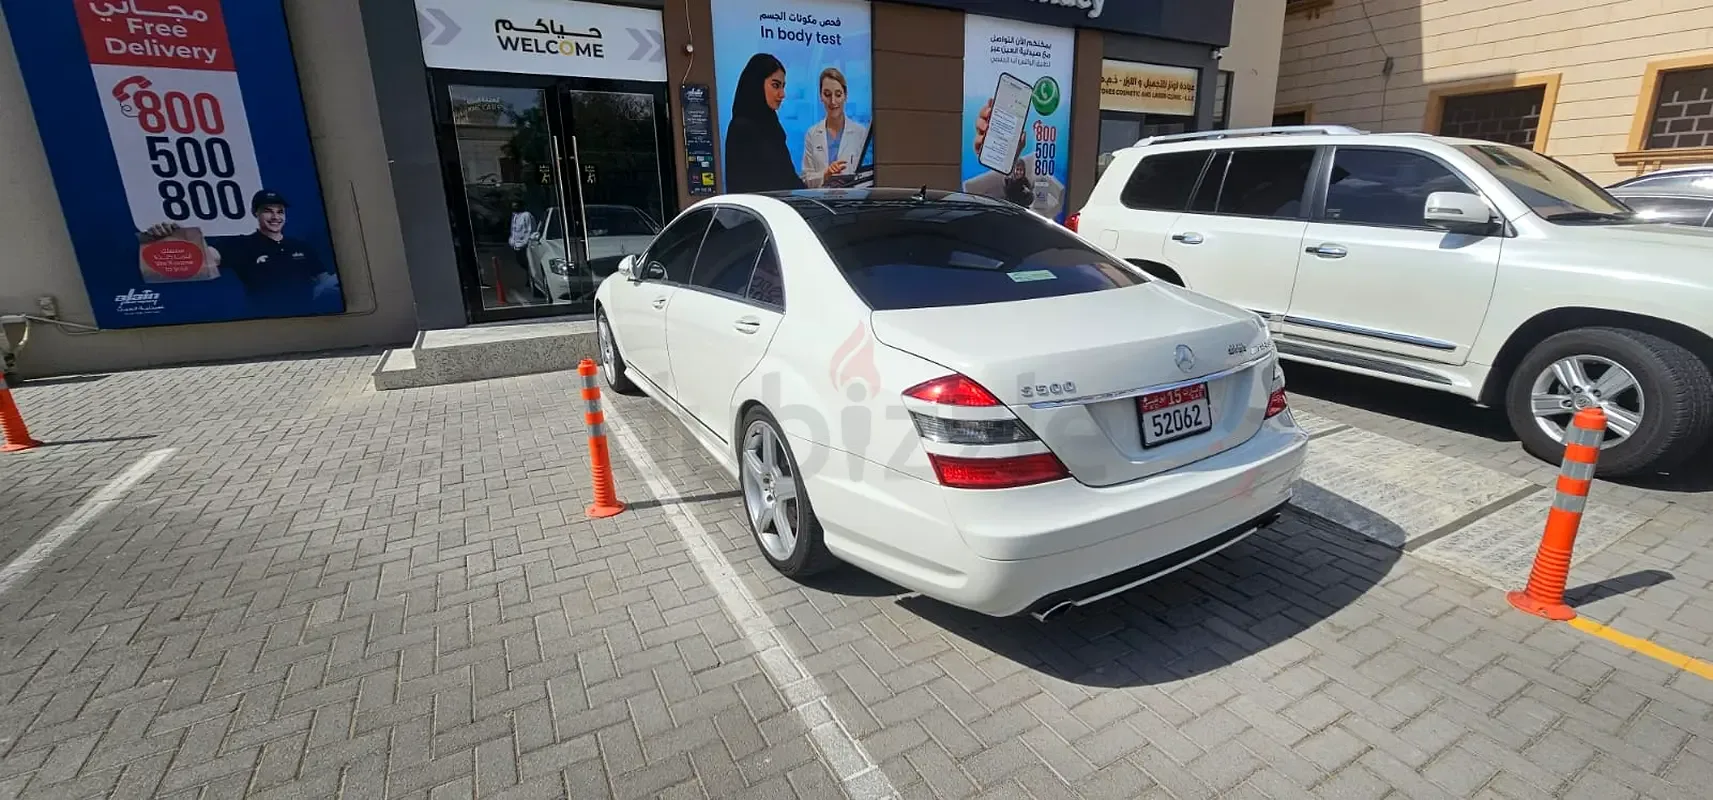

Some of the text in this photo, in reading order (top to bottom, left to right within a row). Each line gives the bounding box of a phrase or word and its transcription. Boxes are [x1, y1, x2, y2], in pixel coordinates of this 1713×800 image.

[126, 17, 188, 37] Free
[495, 18, 602, 39] حياكم
[760, 11, 841, 27] فحص مكونات الجسم
[761, 25, 841, 46] In body test
[105, 37, 217, 63] Delivery
[497, 36, 604, 58] WELCOME
[133, 90, 225, 135] 800
[1035, 126, 1057, 142] 800
[145, 136, 235, 178] 500
[1035, 142, 1056, 159] 500
[1034, 159, 1055, 176] 800
[158, 180, 246, 221] 800
[1167, 389, 1182, 405] 15
[1152, 404, 1202, 437] 52062
